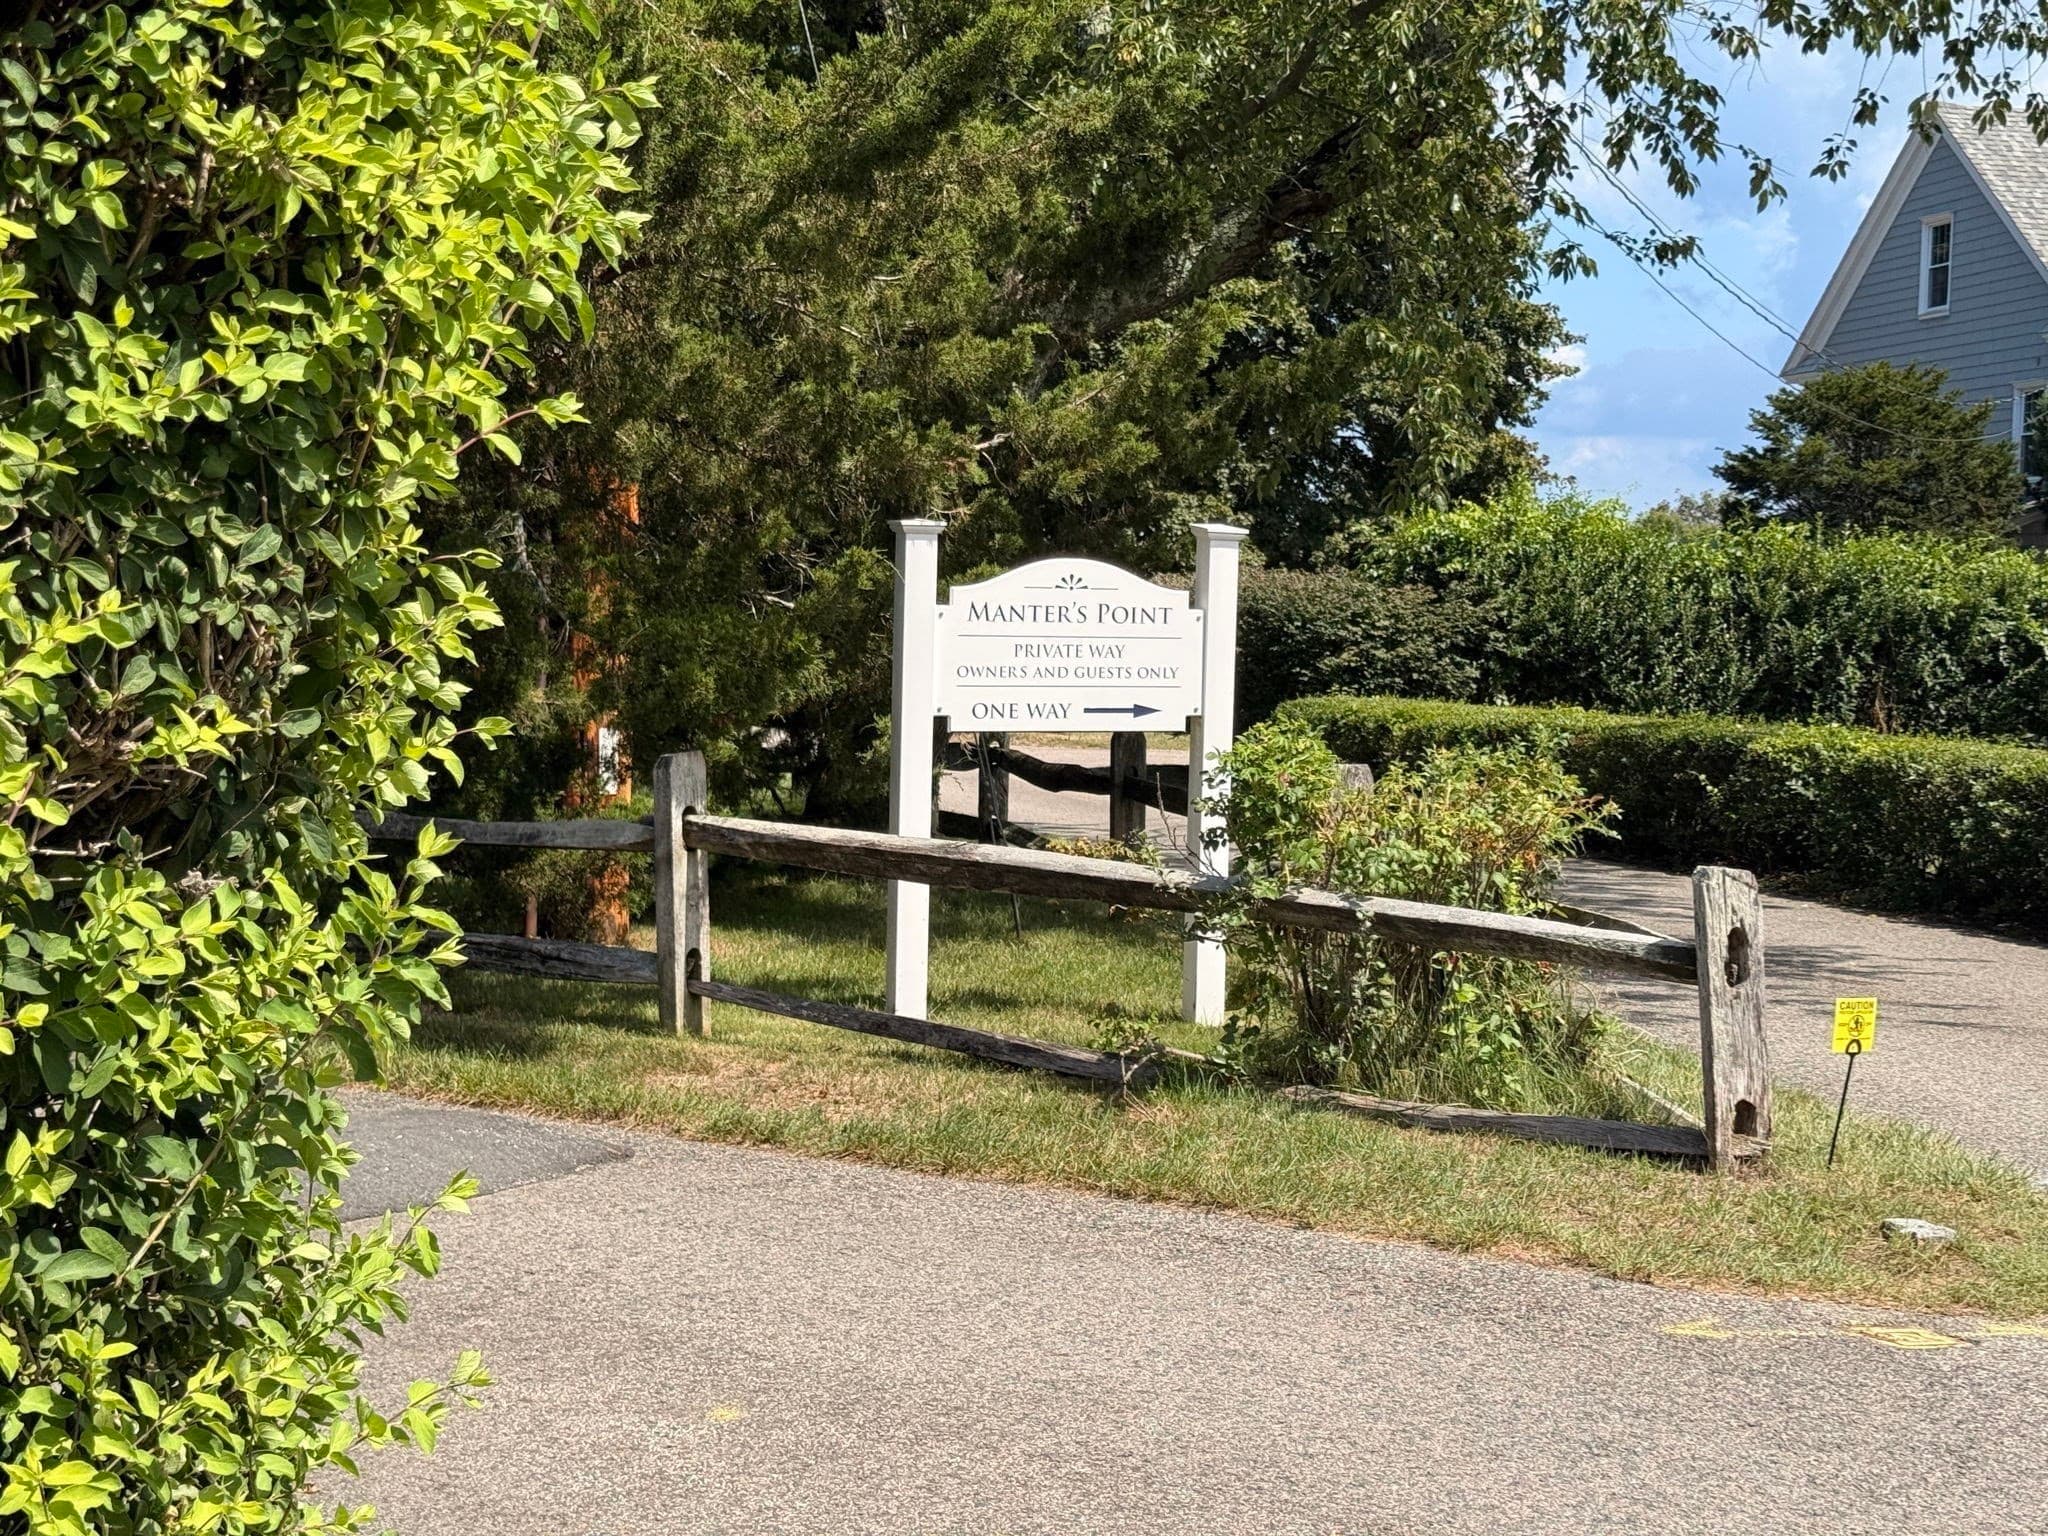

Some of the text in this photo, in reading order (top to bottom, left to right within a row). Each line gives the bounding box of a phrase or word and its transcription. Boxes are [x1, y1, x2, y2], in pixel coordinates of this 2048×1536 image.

[968, 601, 1173, 625] MANTER'S POINT
[1014, 644, 1126, 659] PRIVATE WAY
[956, 665, 1180, 680] OWNERS AND GUESTS ONLY
[972, 703, 1072, 720] ONE WAY
[1839, 1002, 1874, 1010] CAUTION
